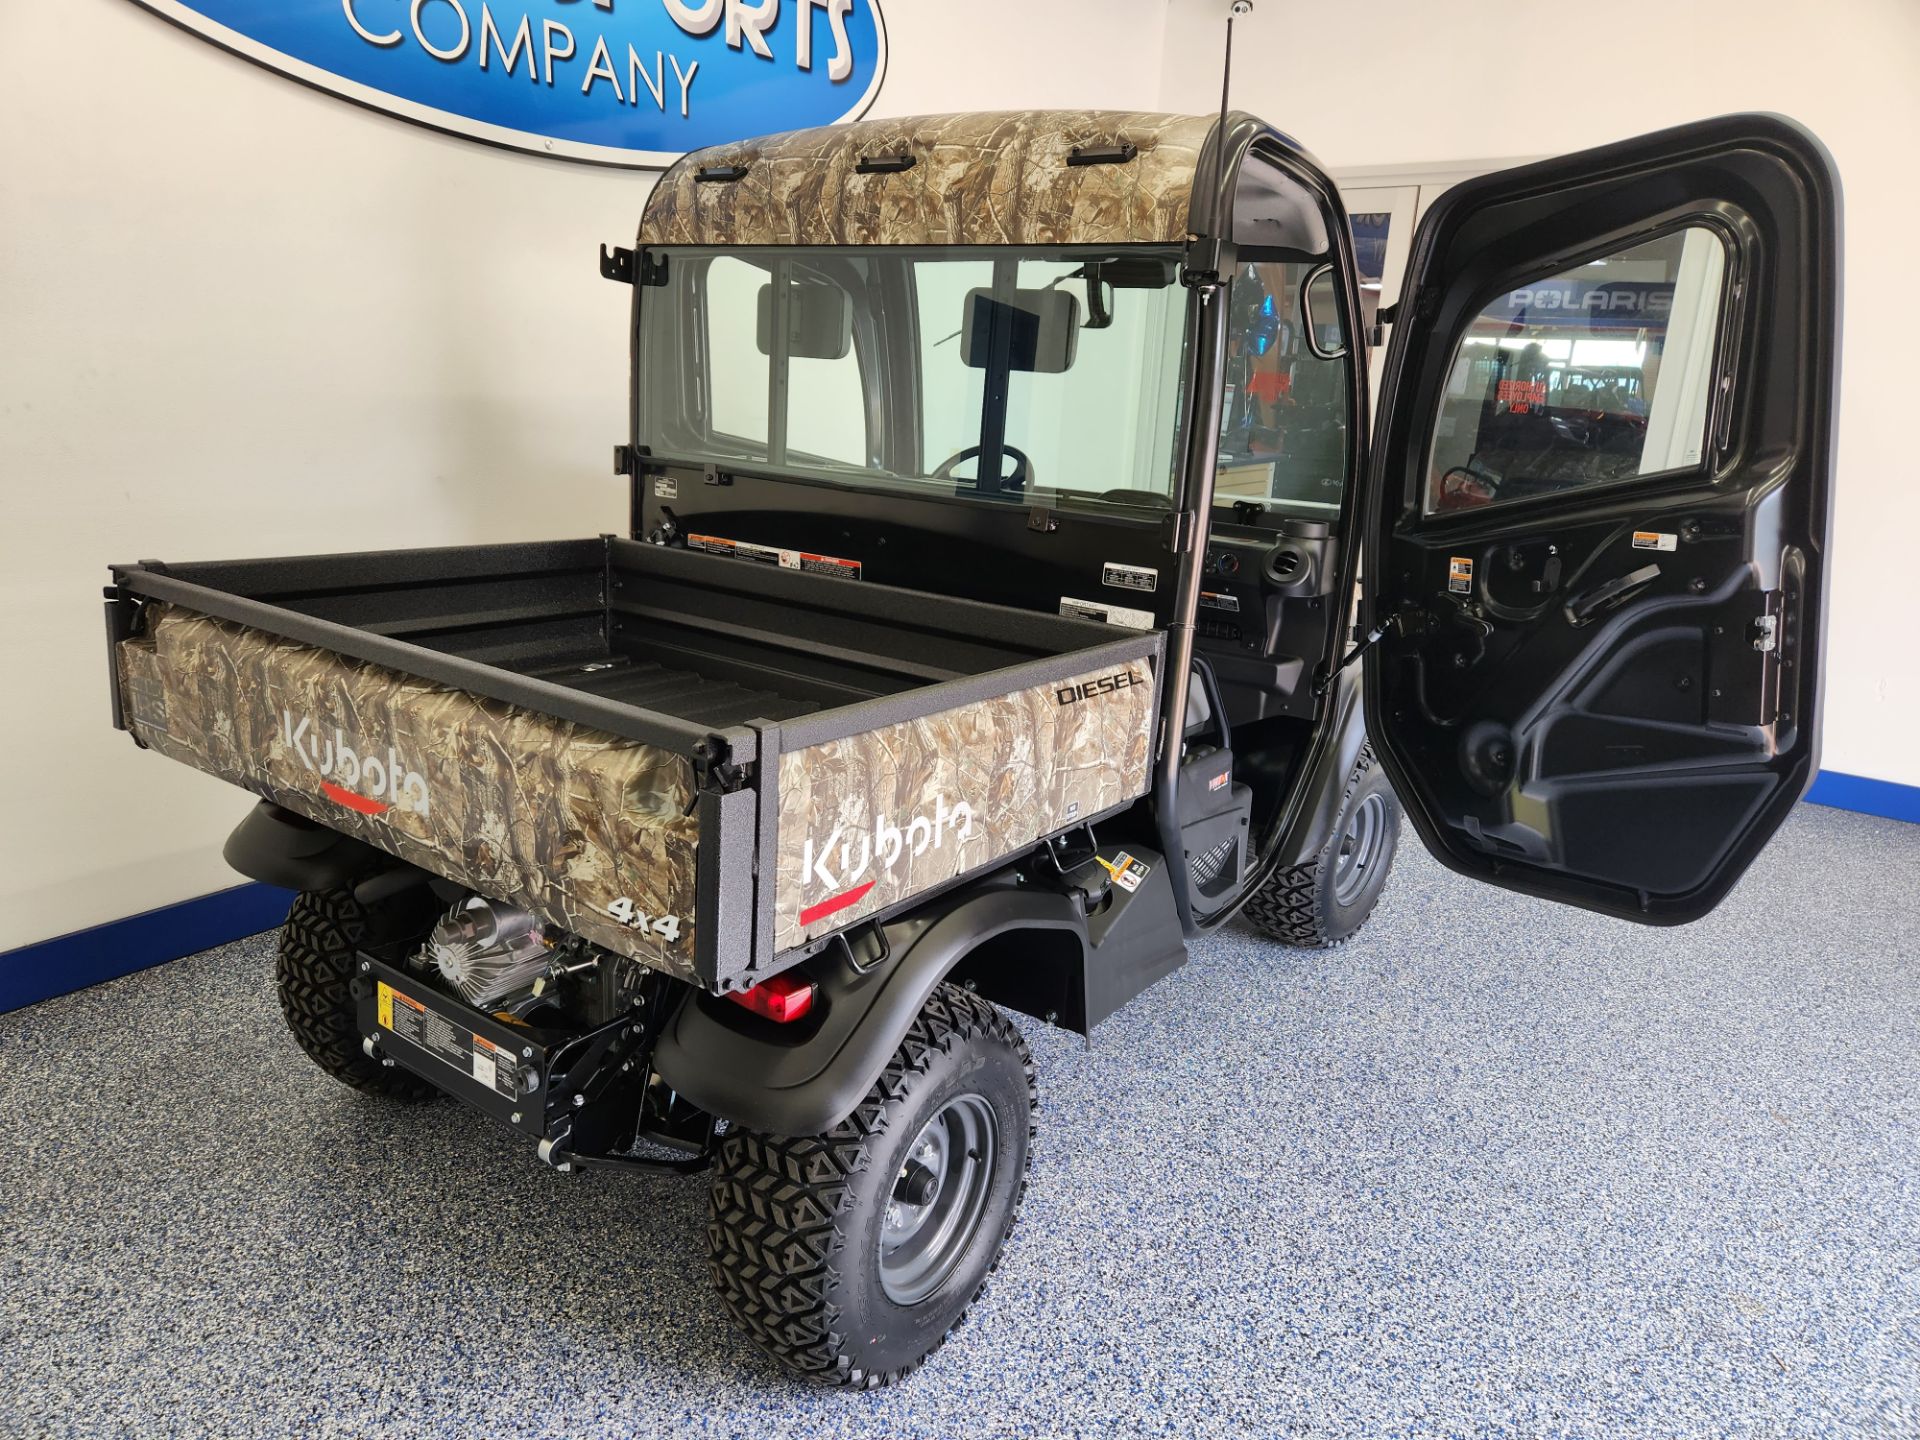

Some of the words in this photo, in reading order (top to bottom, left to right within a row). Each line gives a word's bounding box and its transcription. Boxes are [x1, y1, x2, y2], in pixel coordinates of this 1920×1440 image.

[342, 0, 699, 116] COMPANY
[1507, 289, 1674, 311] POLARIS
[1057, 671, 1144, 706] DIESEL
[284, 710, 430, 817] Kubota
[802, 793, 972, 891] Kubota
[607, 896, 681, 943] 4x4
